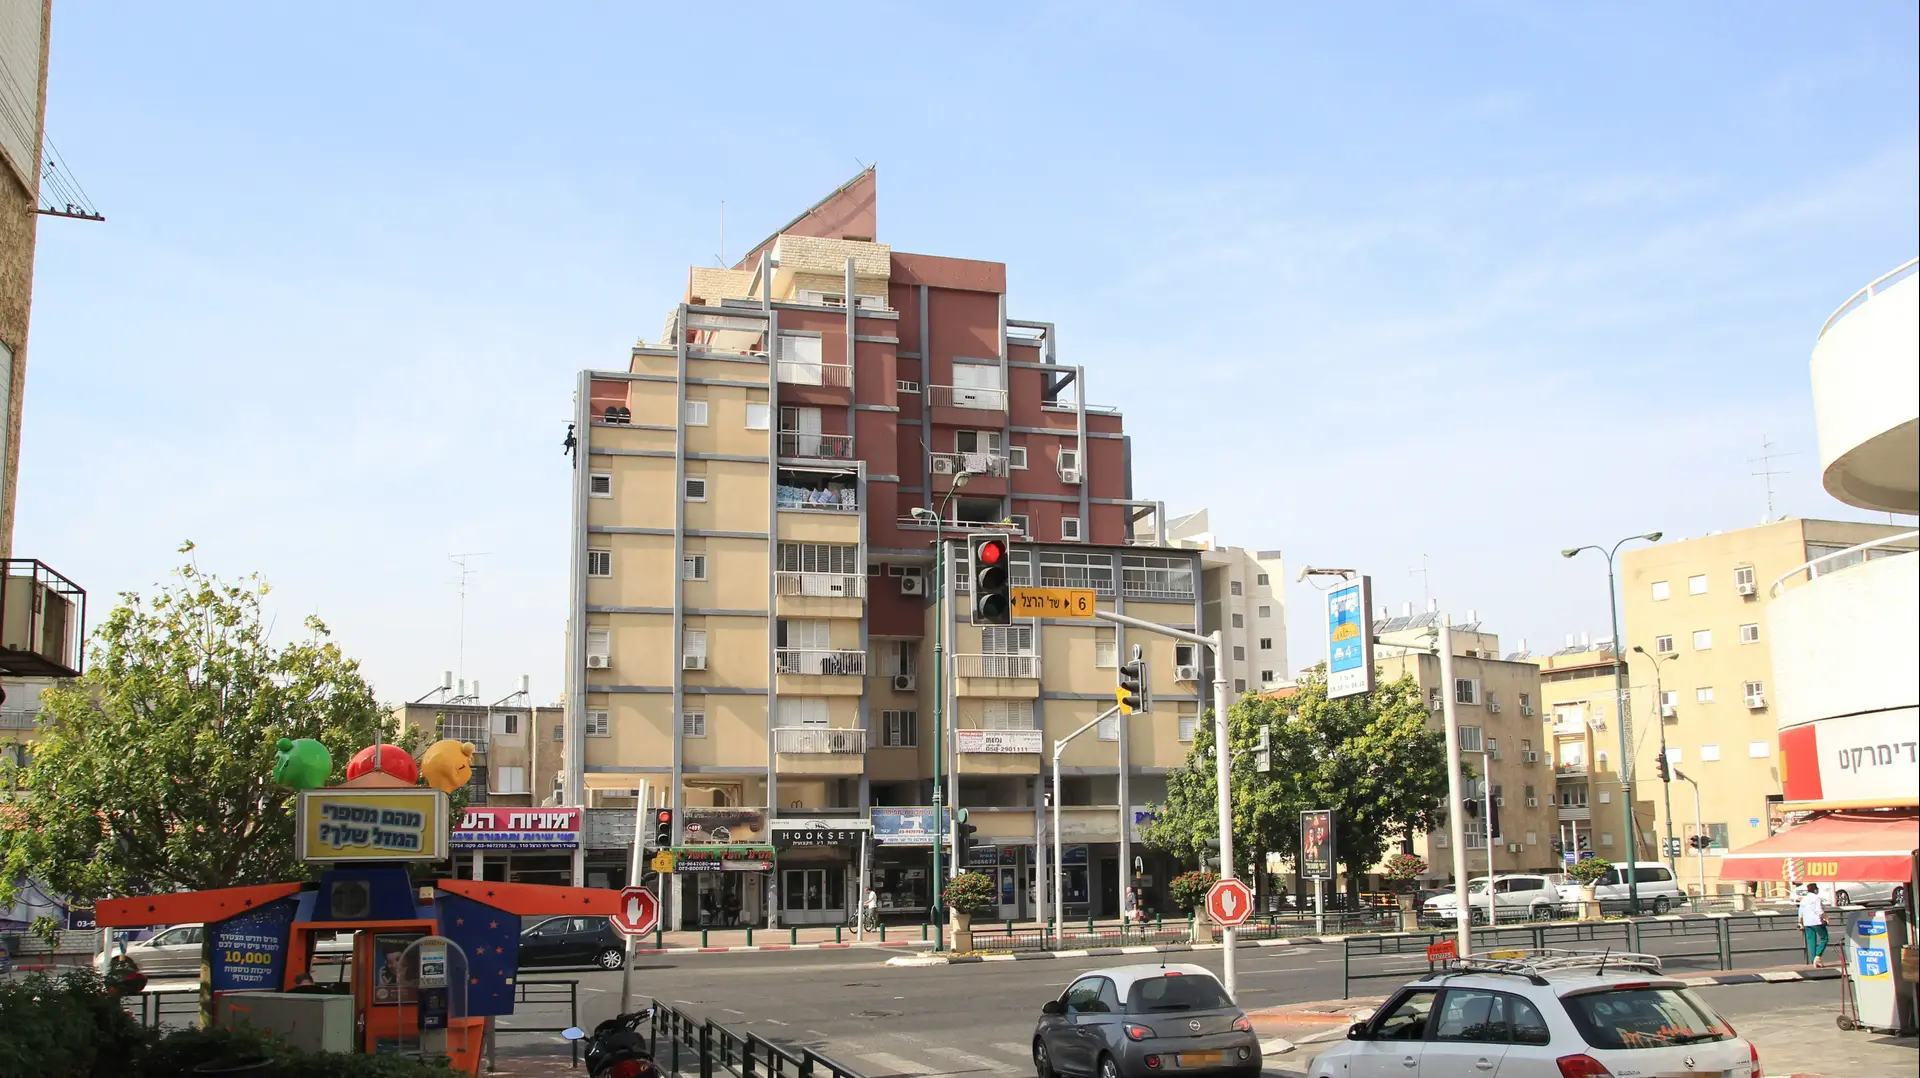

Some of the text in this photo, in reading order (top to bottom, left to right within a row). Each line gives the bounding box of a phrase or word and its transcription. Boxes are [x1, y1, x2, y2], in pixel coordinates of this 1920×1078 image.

[1021, 592, 1044, 608] הרצל
[1078, 597, 1086, 610] 6
[1838, 742, 1917, 774] דימרקט
[322, 803, 421, 828] מהם מספרי
[320, 823, 419, 848] המזל שלך?
[782, 832, 855, 840] HOOKSET
[1807, 862, 1838, 876] טוטו
[220, 933, 244, 941] מצטרף
[263, 936, 278, 944] פרס
[218, 940, 233, 948] לכם
[224, 950, 272, 965] 10,000
[224, 965, 272, 975] סיבות נוספות
[232, 974, 264, 982] להצטרף!
